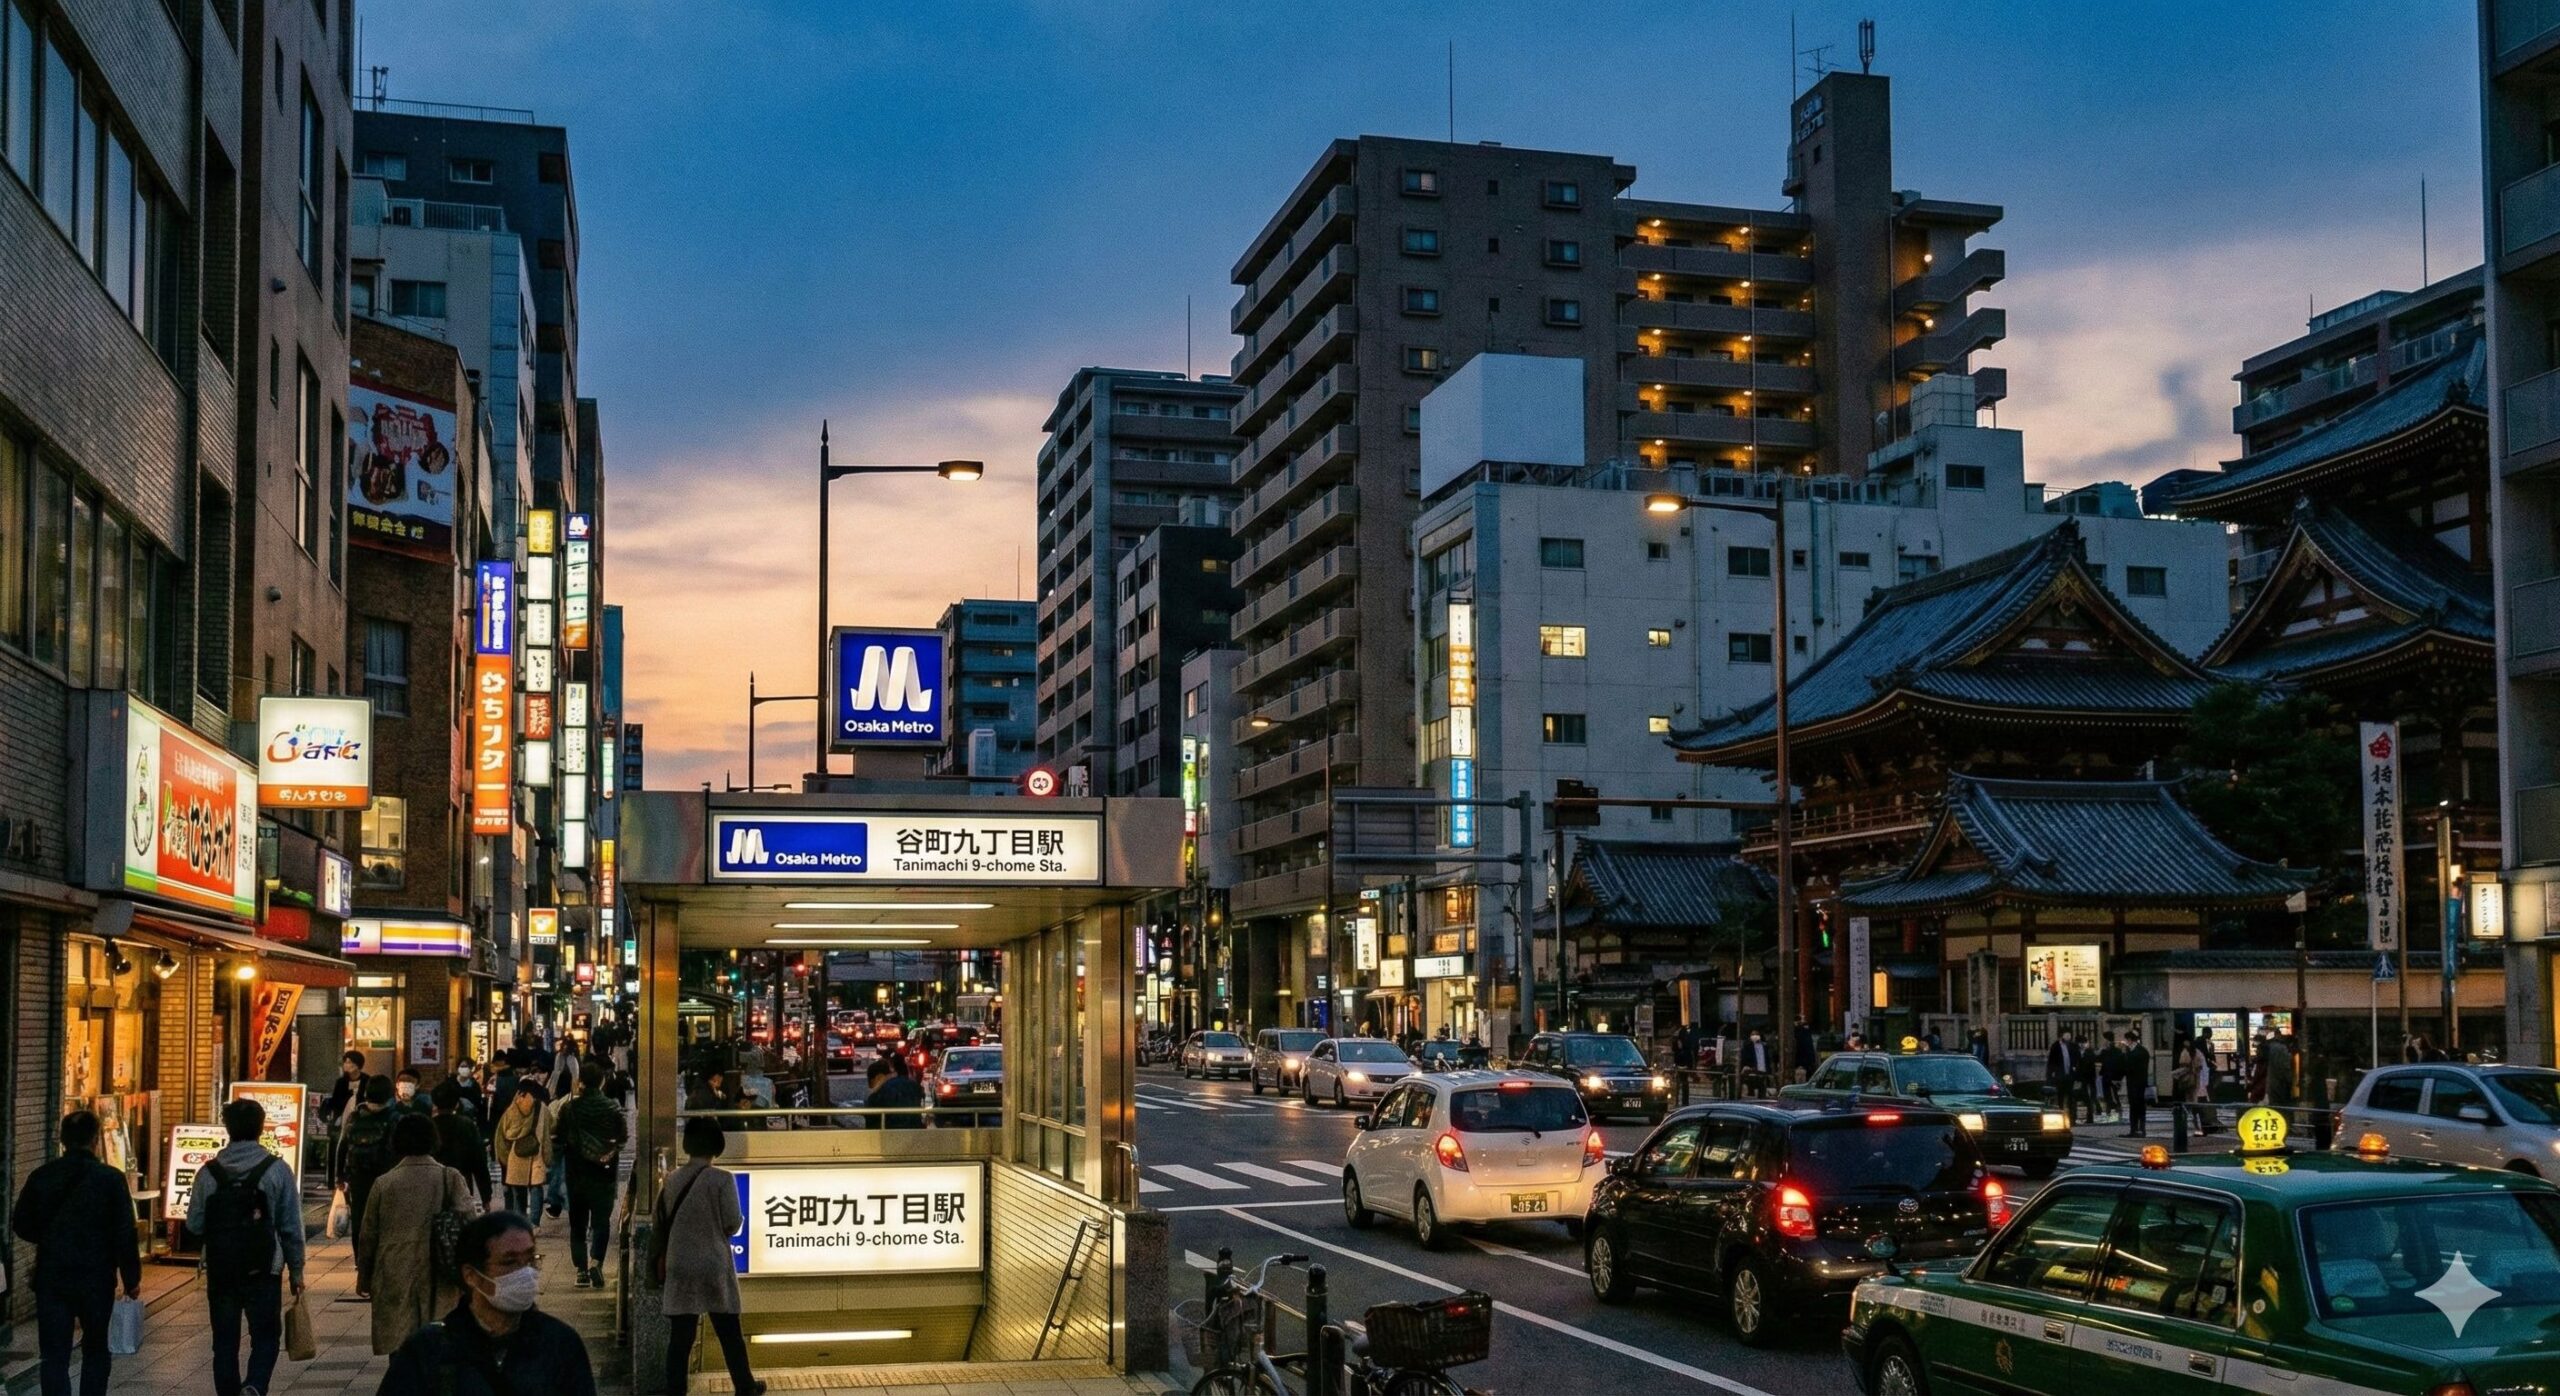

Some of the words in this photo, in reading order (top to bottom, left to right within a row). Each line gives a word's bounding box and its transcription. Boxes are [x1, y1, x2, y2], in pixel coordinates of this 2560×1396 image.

[844, 719, 890, 732] Osaka
[891, 720, 934, 734] Metro
[896, 828, 1064, 856] 谷町九丁目駅
[774, 852, 818, 865] Osaka
[820, 852, 862, 866] Metro
[893, 858, 968, 871] Tanimachi
[972, 858, 1035, 872] 9-chome
[1039, 859, 1067, 872] Sta.
[764, 1192, 965, 1228] 谷町九丁目駅
[765, 1232, 850, 1248] Tanimachi
[855, 1231, 928, 1246] 9-chome
[933, 1229, 964, 1244] Sta.
